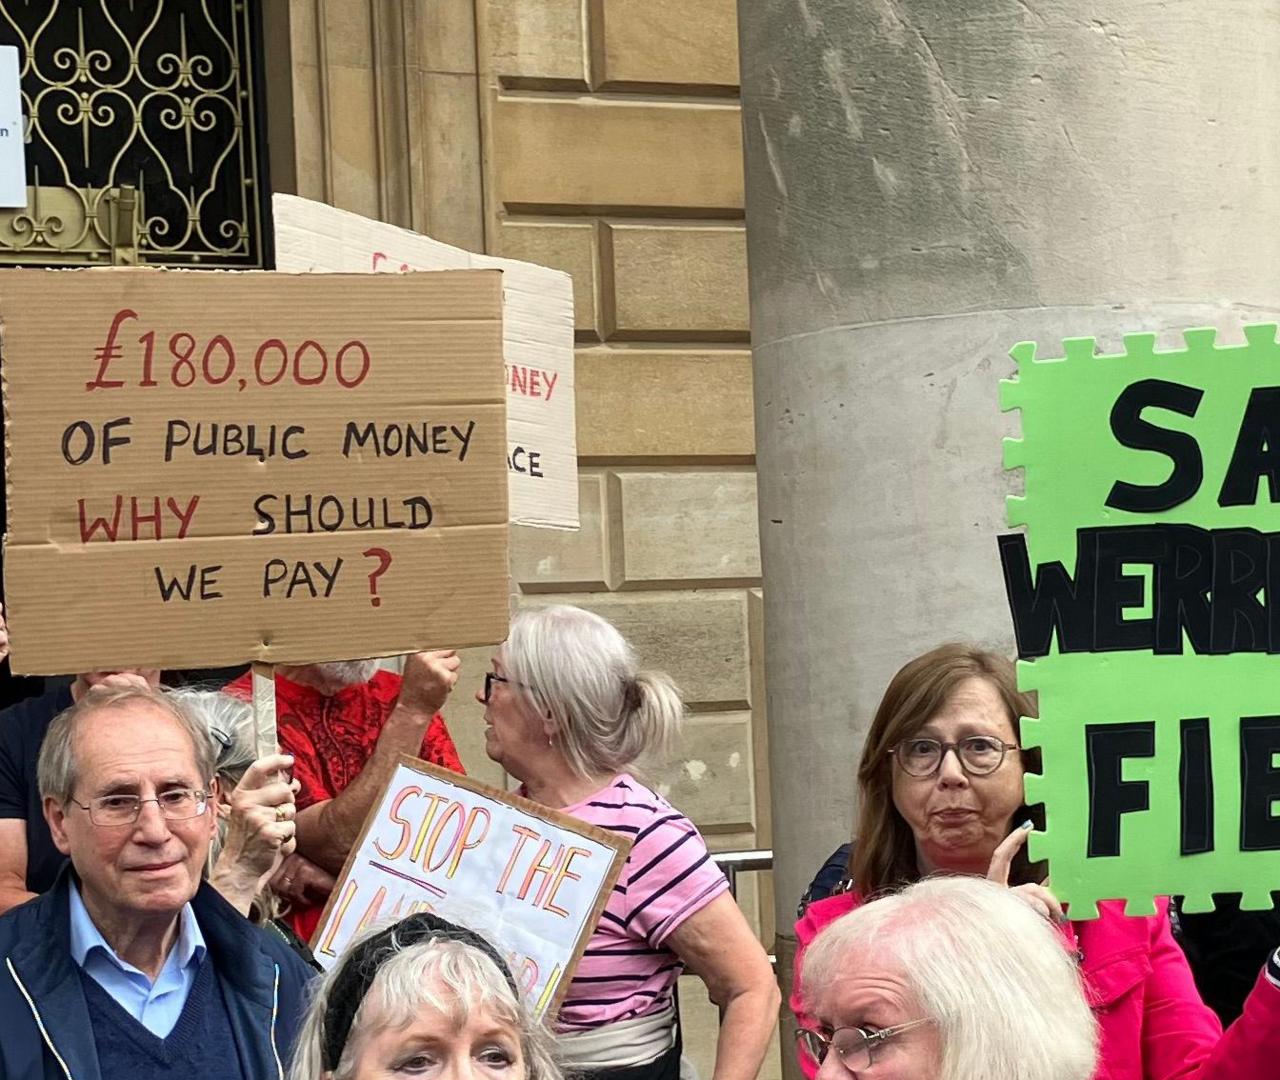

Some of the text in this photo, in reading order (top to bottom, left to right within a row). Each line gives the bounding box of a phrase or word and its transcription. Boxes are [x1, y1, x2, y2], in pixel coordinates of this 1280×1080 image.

[85, 308, 371, 392] £180,000
[505, 364, 558, 402] NEY
[61, 416, 476, 466] OF PUBLIC MONEY
[79, 493, 434, 544] WHY SHOULD
[155, 563, 223, 602] WE
[371, 785, 593, 919] STOP THE
